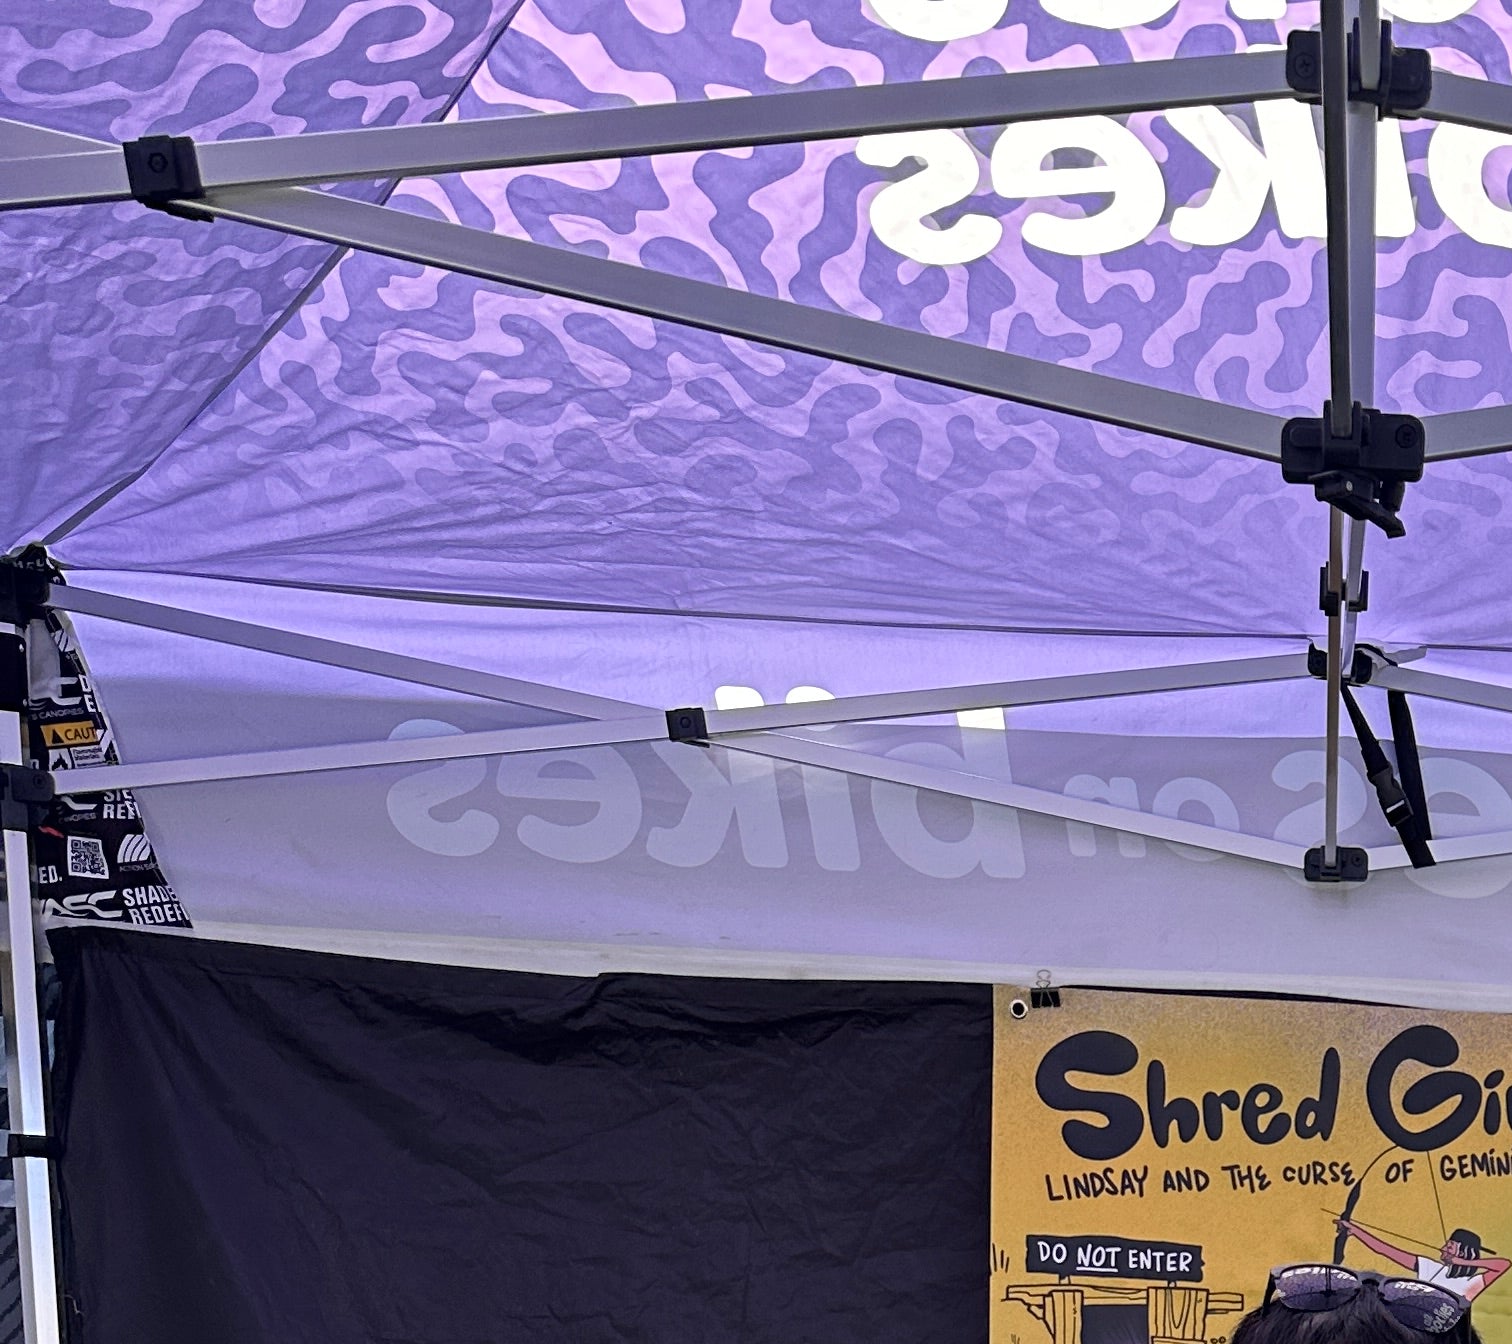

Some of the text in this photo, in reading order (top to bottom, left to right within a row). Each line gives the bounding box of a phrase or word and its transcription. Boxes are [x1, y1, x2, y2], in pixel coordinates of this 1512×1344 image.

[1035, 1029, 1341, 1160] Shred
[1045, 1166, 1149, 1201] LINDSAY
[1163, 1169, 1209, 1193] AND
[1222, 1164, 1272, 1193] THE
[1283, 1161, 1356, 1187] CURSE
[1385, 1160, 1415, 1184] OF
[1037, 1241, 1192, 1272] DO NOT ENTER
